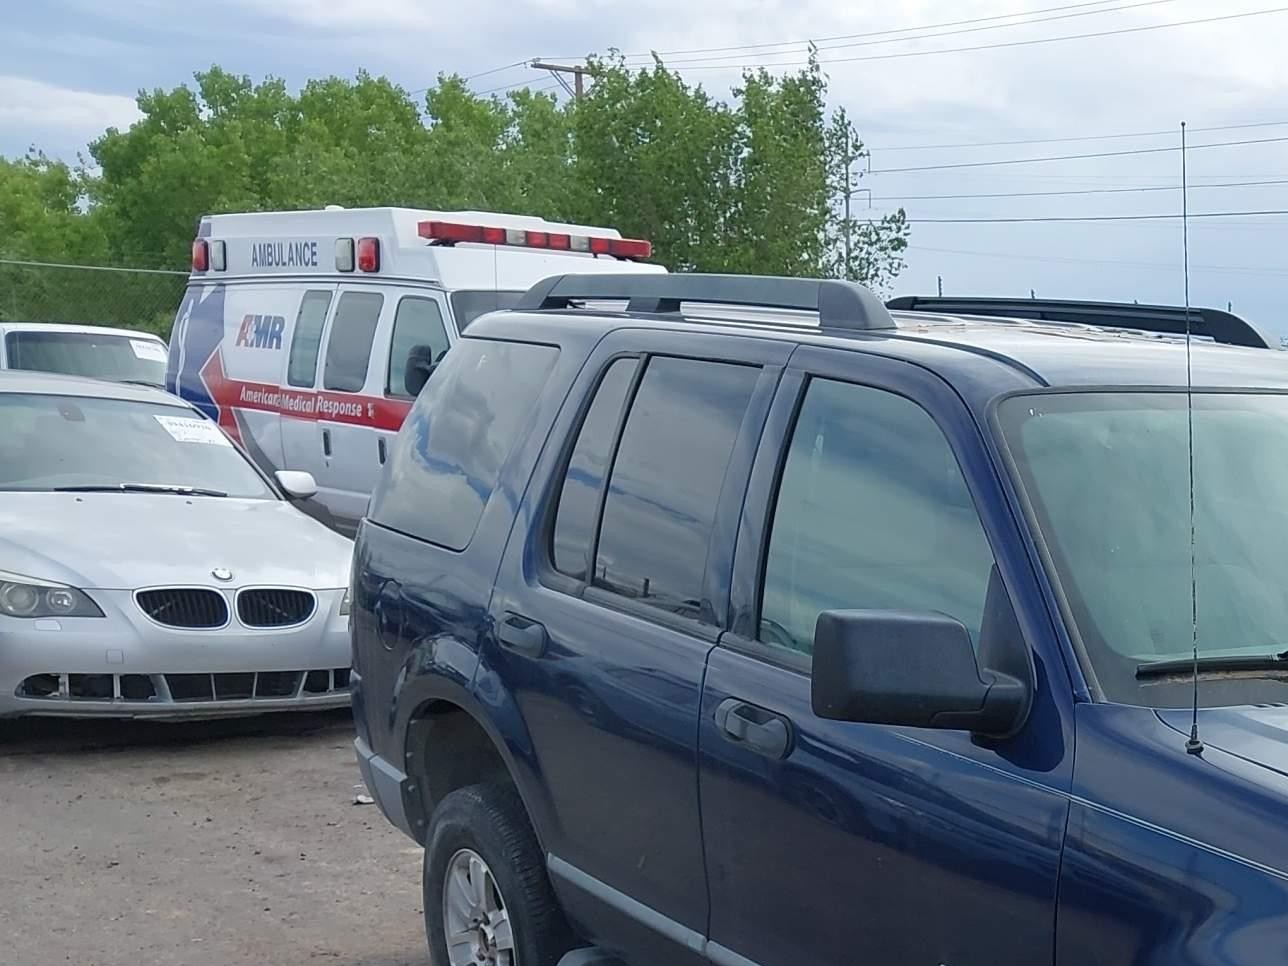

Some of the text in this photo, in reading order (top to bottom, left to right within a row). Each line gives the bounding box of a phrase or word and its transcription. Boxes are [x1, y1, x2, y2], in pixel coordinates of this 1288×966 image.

[252, 242, 318, 267] AMBULANCE
[235, 314, 285, 349] AMR
[240, 386, 362, 417] American Medical Response
